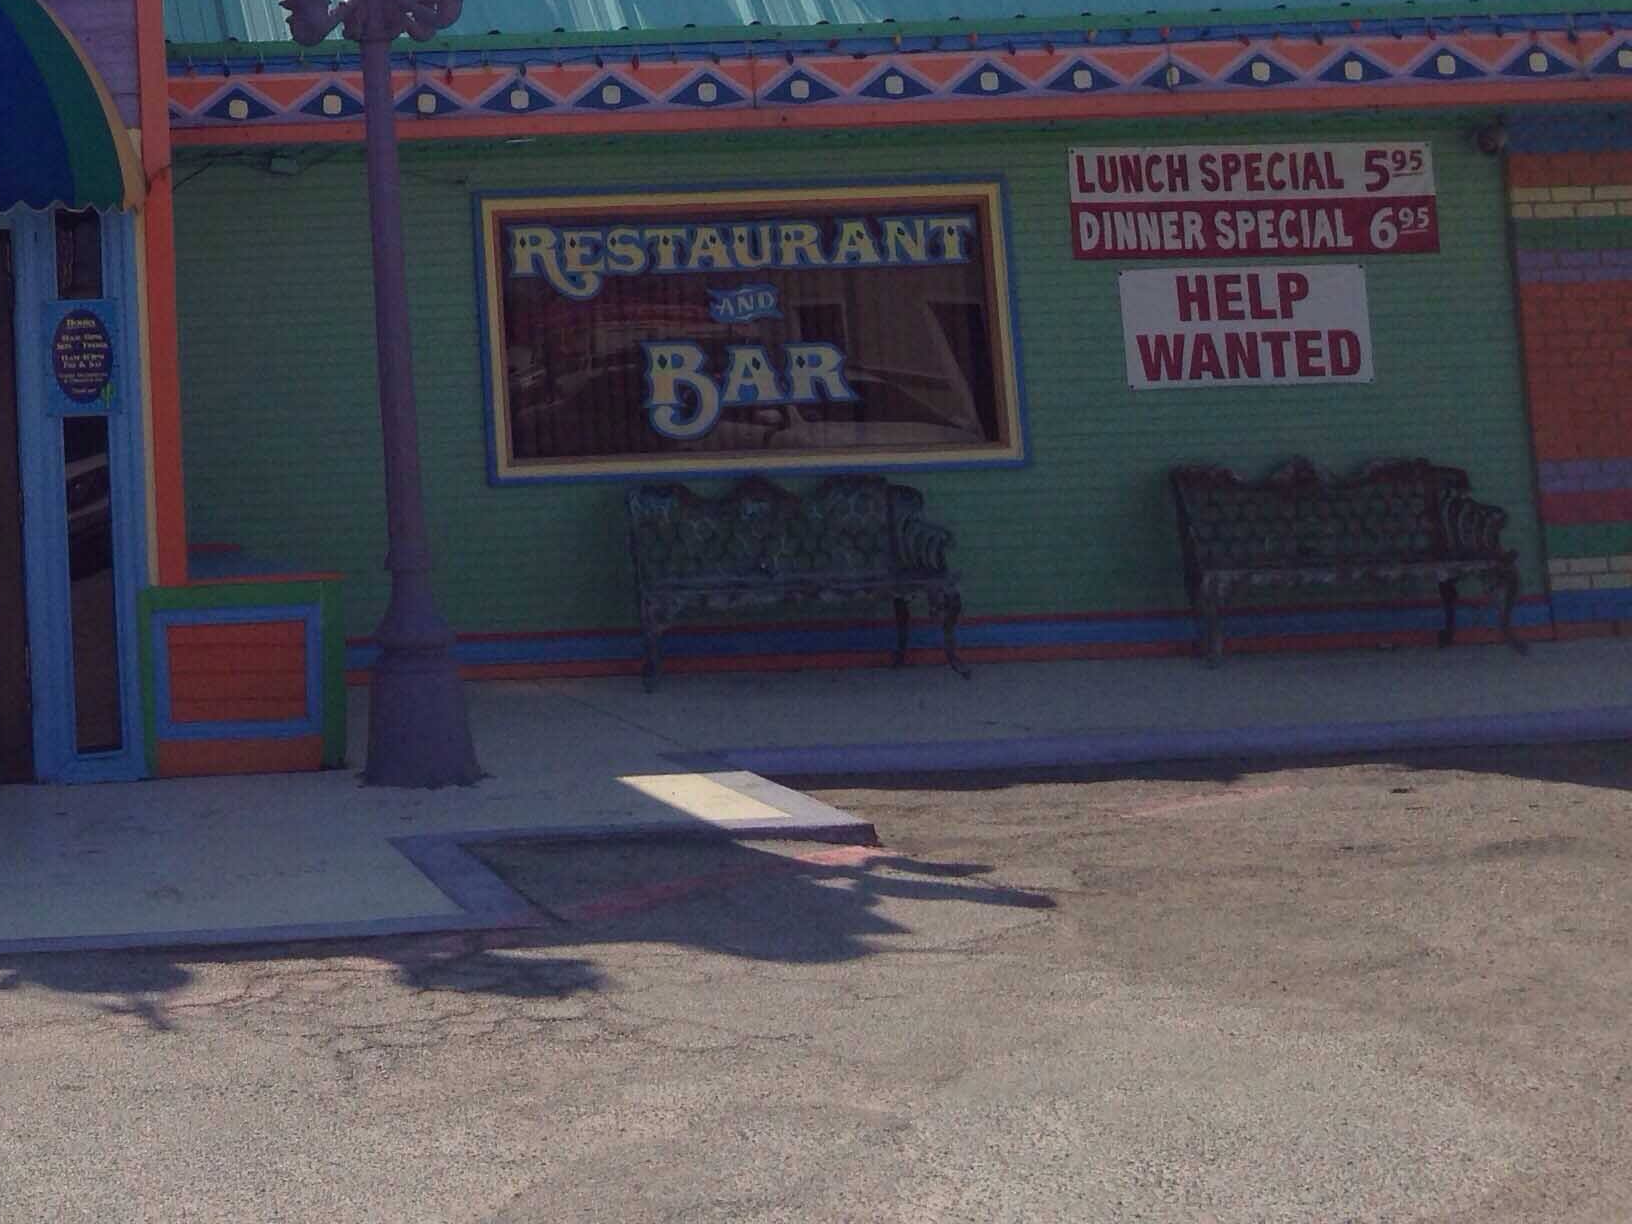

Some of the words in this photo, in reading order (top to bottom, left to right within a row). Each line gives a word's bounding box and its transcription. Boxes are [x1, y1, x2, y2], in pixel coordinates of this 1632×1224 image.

[1075, 153, 1190, 193] LUNCH
[1198, 151, 1345, 192] SPECIAL
[1079, 210, 1207, 252] DINNER
[1215, 208, 1353, 250] SPECIAL
[510, 217, 973, 297] RESTAURANT
[716, 290, 775, 317] AND
[1174, 272, 1310, 322] HELP
[1135, 328, 1362, 382] WANTED
[646, 342, 850, 437] BAR
